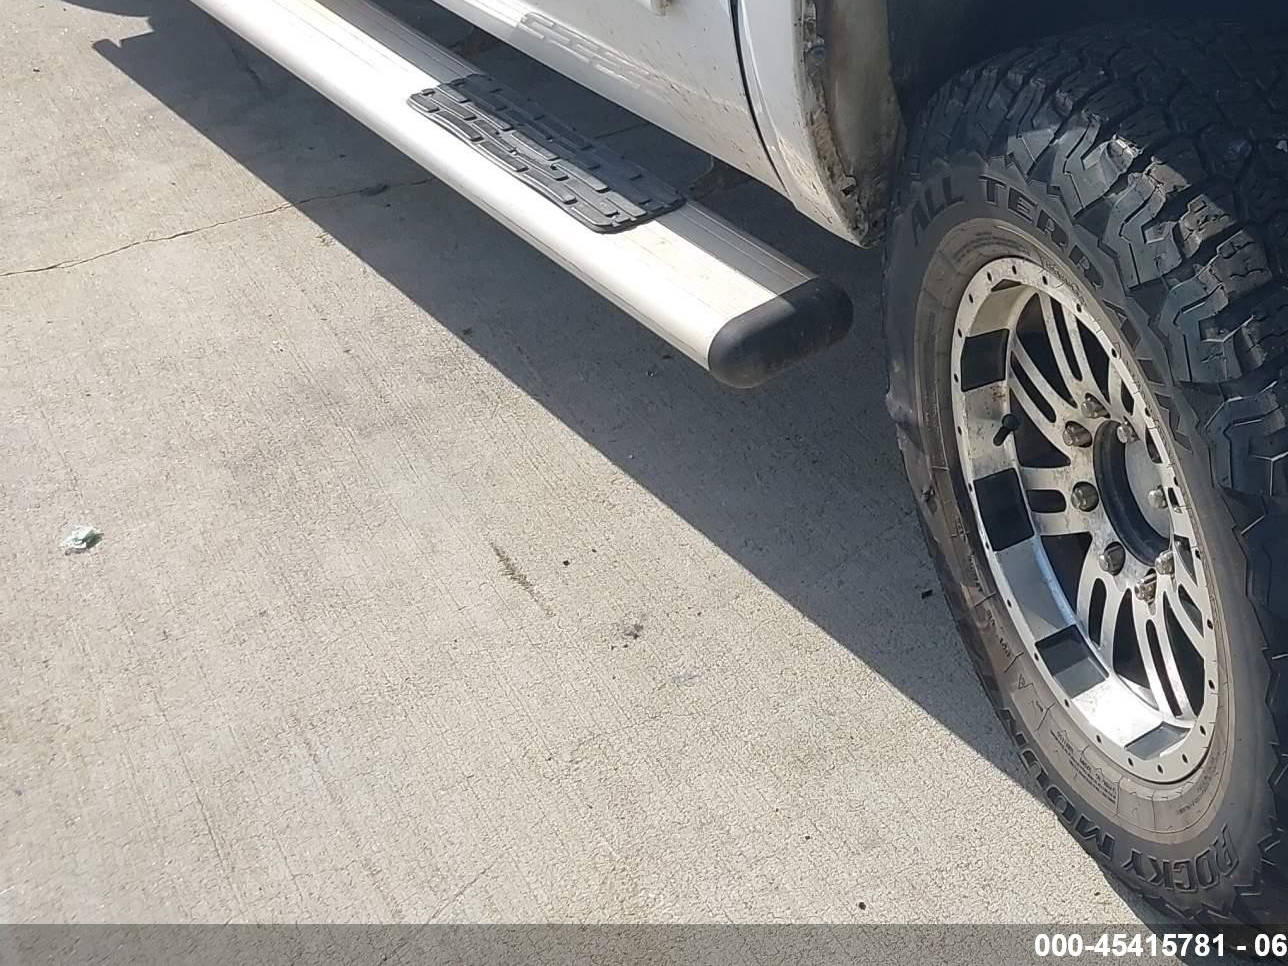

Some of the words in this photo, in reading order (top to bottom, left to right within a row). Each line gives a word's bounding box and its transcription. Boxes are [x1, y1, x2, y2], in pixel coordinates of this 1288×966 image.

[911, 174, 967, 248] ALL
[978, 174, 1195, 455] TERRAIN
[1122, 823, 1240, 894] ROCKY
